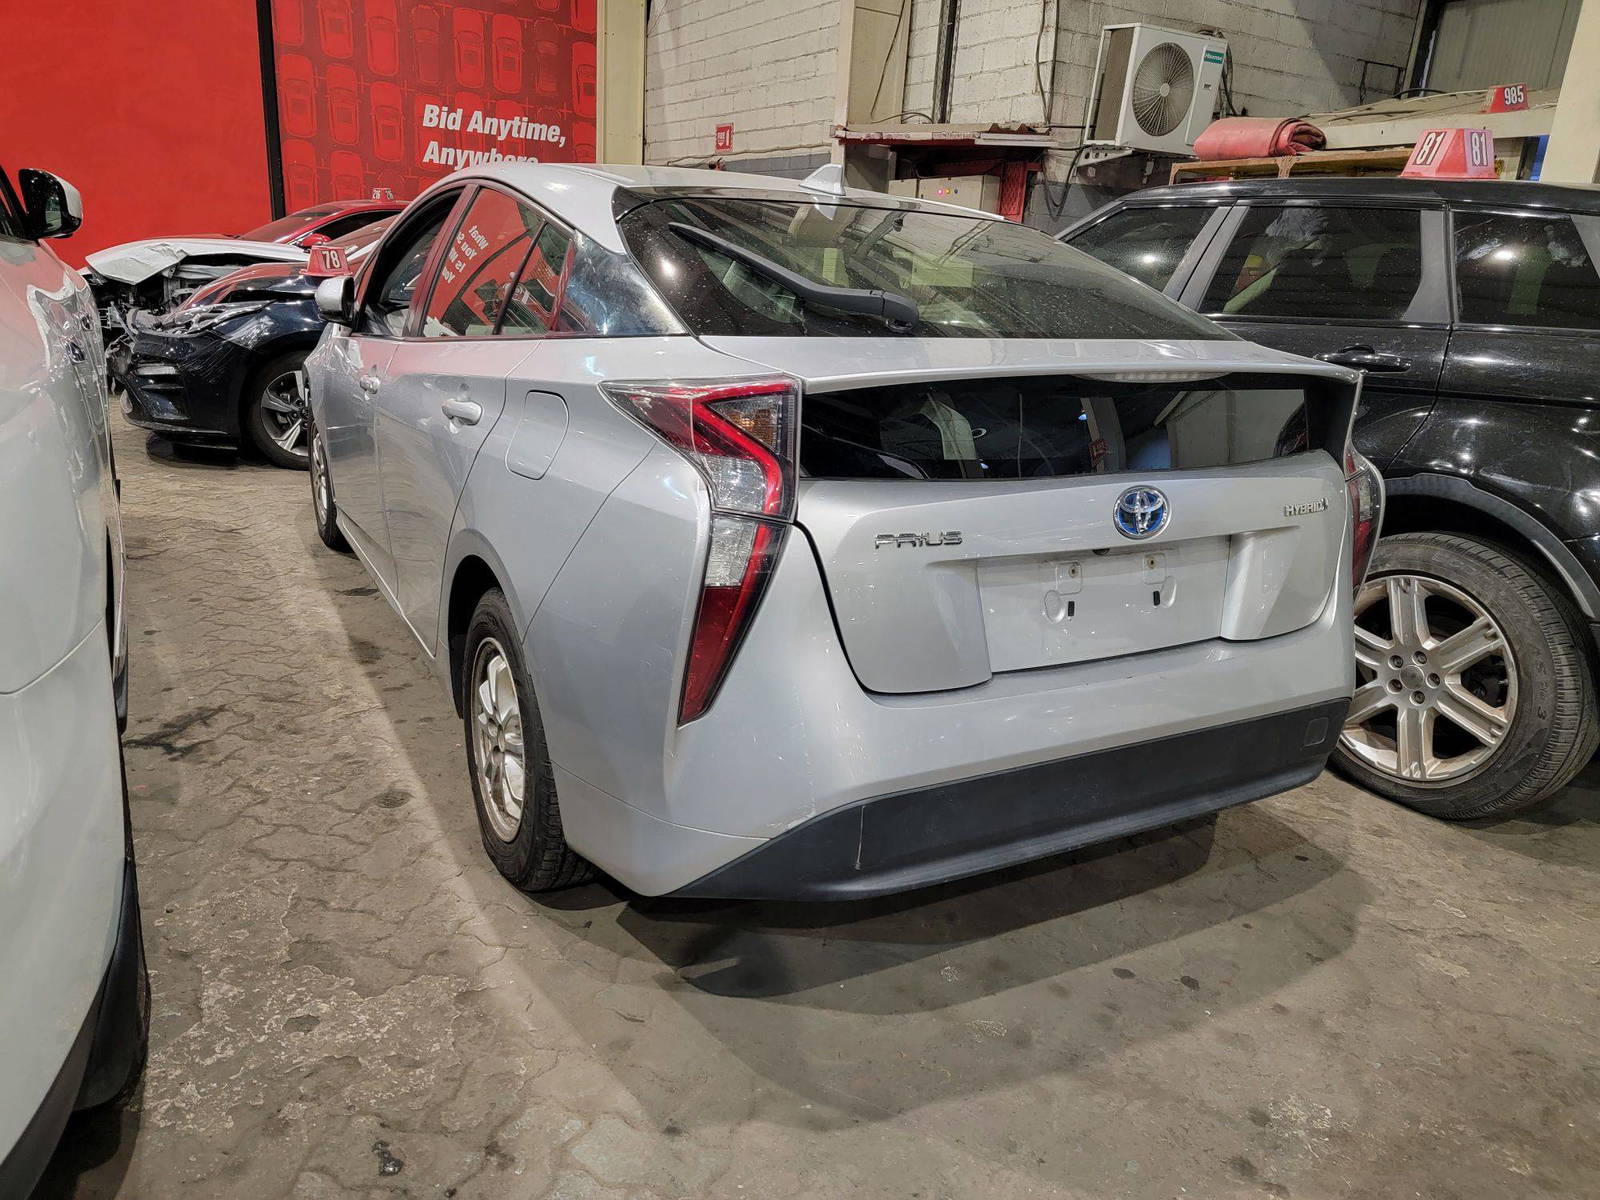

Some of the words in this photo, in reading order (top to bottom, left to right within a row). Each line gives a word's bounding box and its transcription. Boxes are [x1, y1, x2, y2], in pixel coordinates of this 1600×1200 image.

[1504, 85, 1525, 106] 985
[422, 103, 464, 131] Bid
[466, 110, 567, 148] Anytime,
[1414, 131, 1447, 165] 81
[1470, 131, 1488, 166] 81
[321, 250, 340, 269] 78
[1284, 500, 1323, 517] HYBRID
[875, 530, 963, 549] PRIUS
